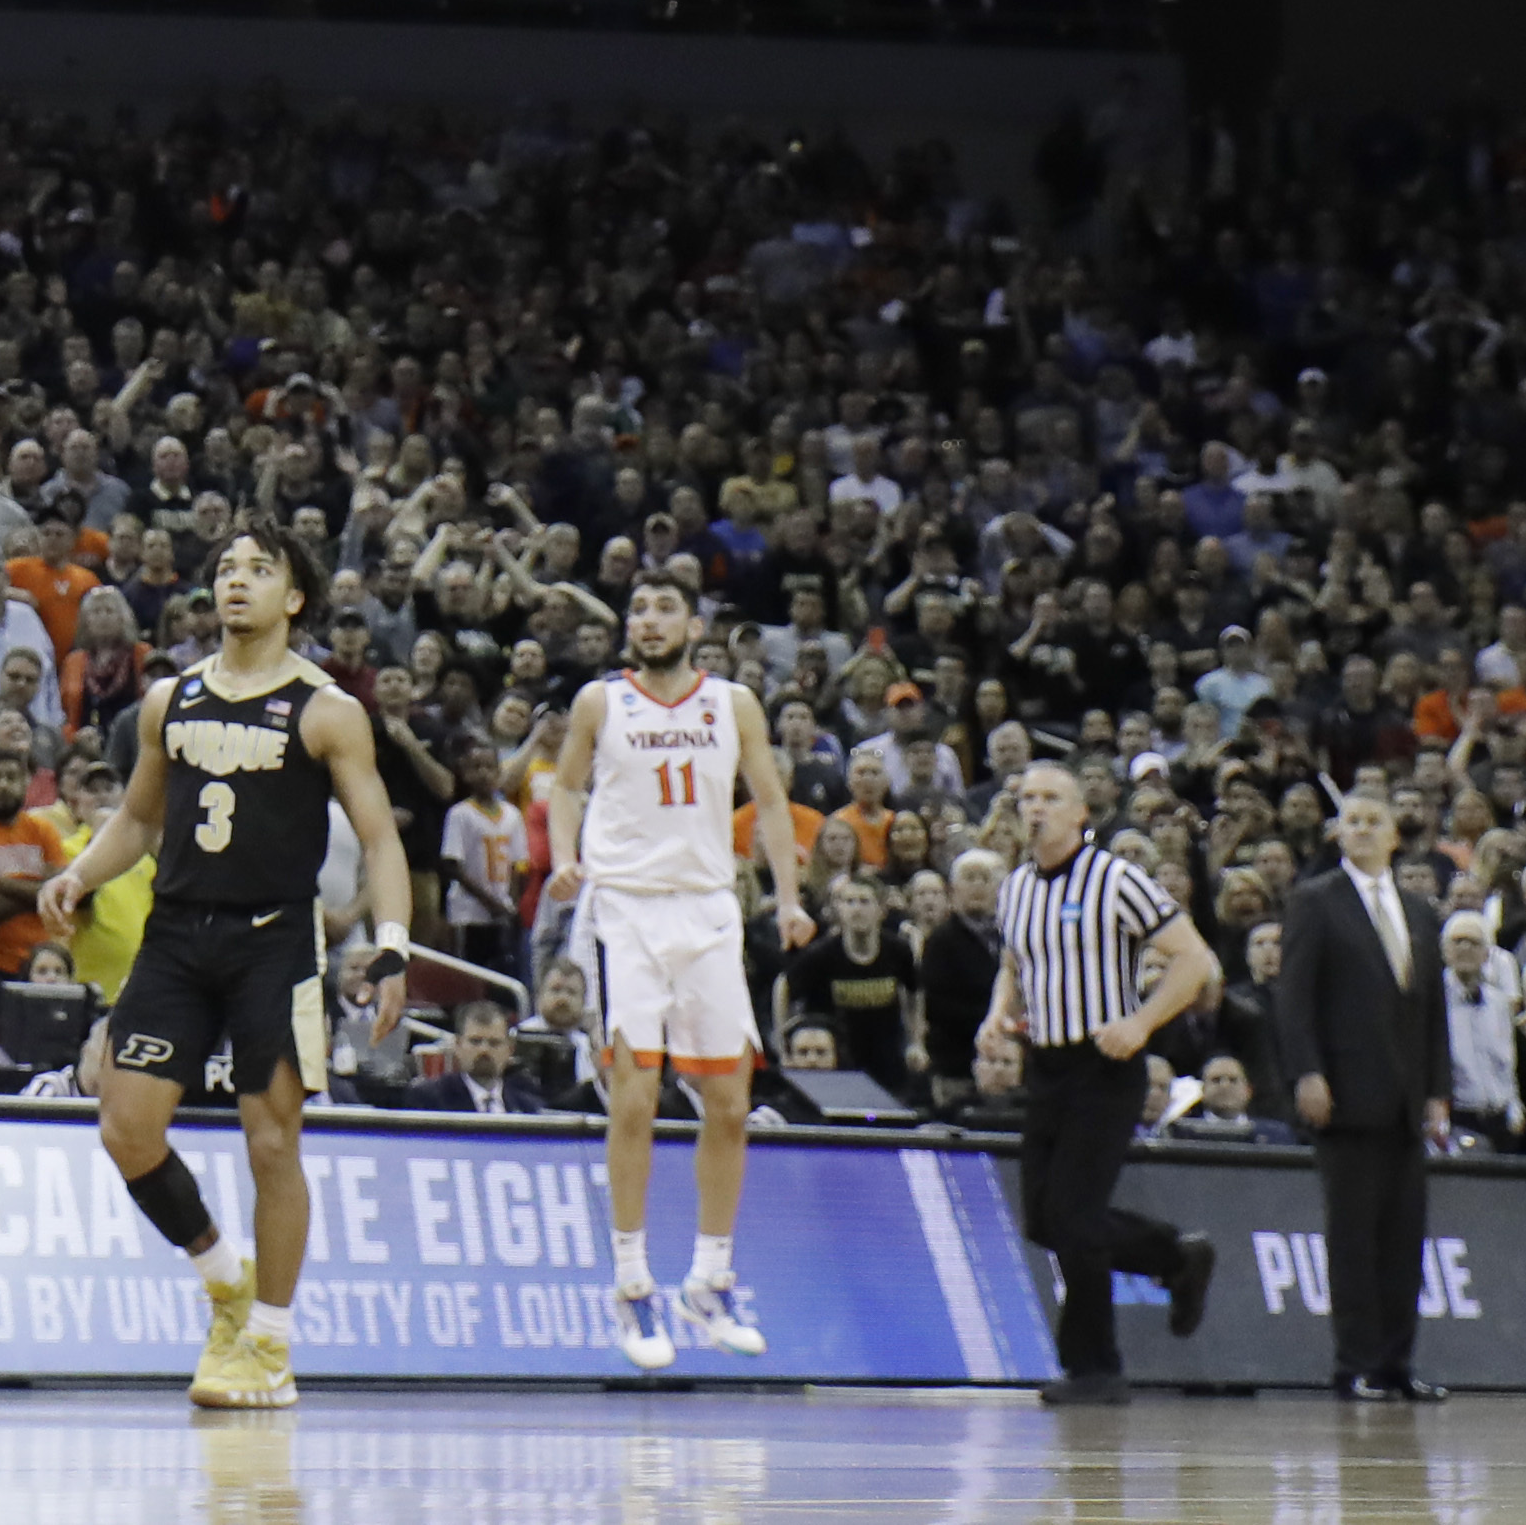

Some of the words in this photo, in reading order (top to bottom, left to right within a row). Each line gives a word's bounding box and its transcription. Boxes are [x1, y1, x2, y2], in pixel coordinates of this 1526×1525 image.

[165, 719, 290, 777] PURDUE
[626, 729, 719, 749] VIRGINIA
[652, 757, 697, 807] 11
[195, 780, 236, 853] 3
[116, 1032, 175, 1067] P
[1251, 1231, 1484, 1320] PUUE
[26, 1275, 95, 1342] BY
[107, 1276, 413, 1348] UNISITY
[422, 1280, 483, 1348] OF
